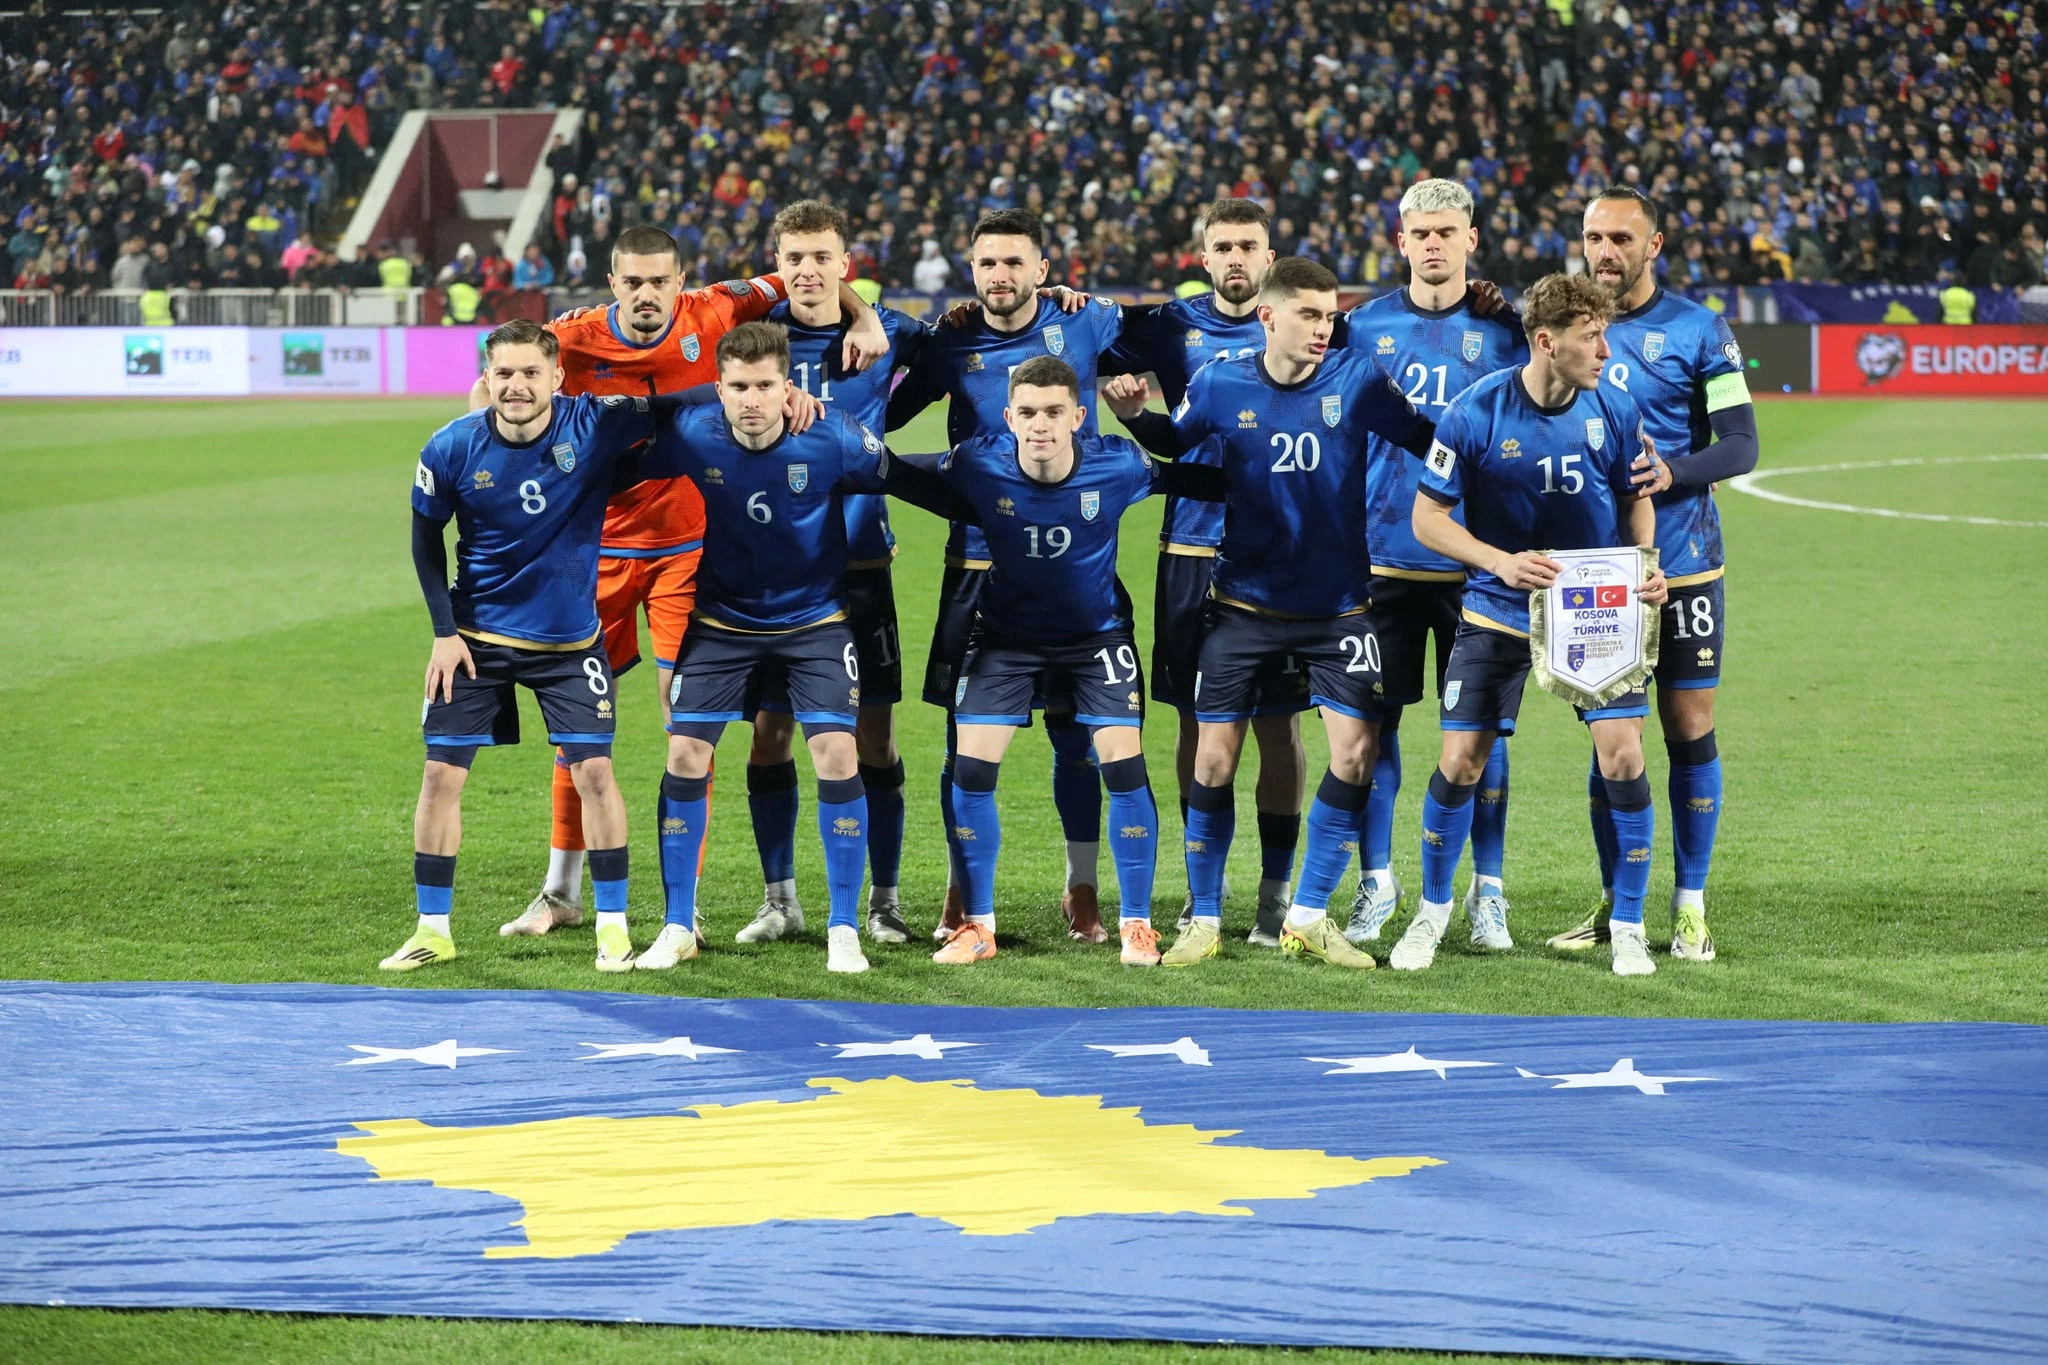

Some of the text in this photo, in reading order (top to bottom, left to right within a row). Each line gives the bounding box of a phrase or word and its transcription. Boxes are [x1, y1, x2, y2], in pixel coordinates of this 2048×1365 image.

[0, 350, 21, 364] EB
[172, 349, 212, 364] TEB
[329, 347, 371, 362] TEB
[794, 361, 834, 401] 11
[1405, 362, 1449, 406] 21
[1709, 385, 1737, 398] ESPECT
[1270, 432, 1320, 473] 20
[1536, 454, 1584, 495] 15
[519, 480, 547, 515] 8
[746, 491, 772, 524] 6
[1023, 525, 1072, 559] 19
[1574, 609, 1618, 620] KOSOVA
[1668, 595, 1715, 640] 18
[843, 642, 859, 682] 6
[1093, 645, 1138, 685] 19
[1339, 632, 1382, 673] 20
[582, 656, 608, 695] 8
